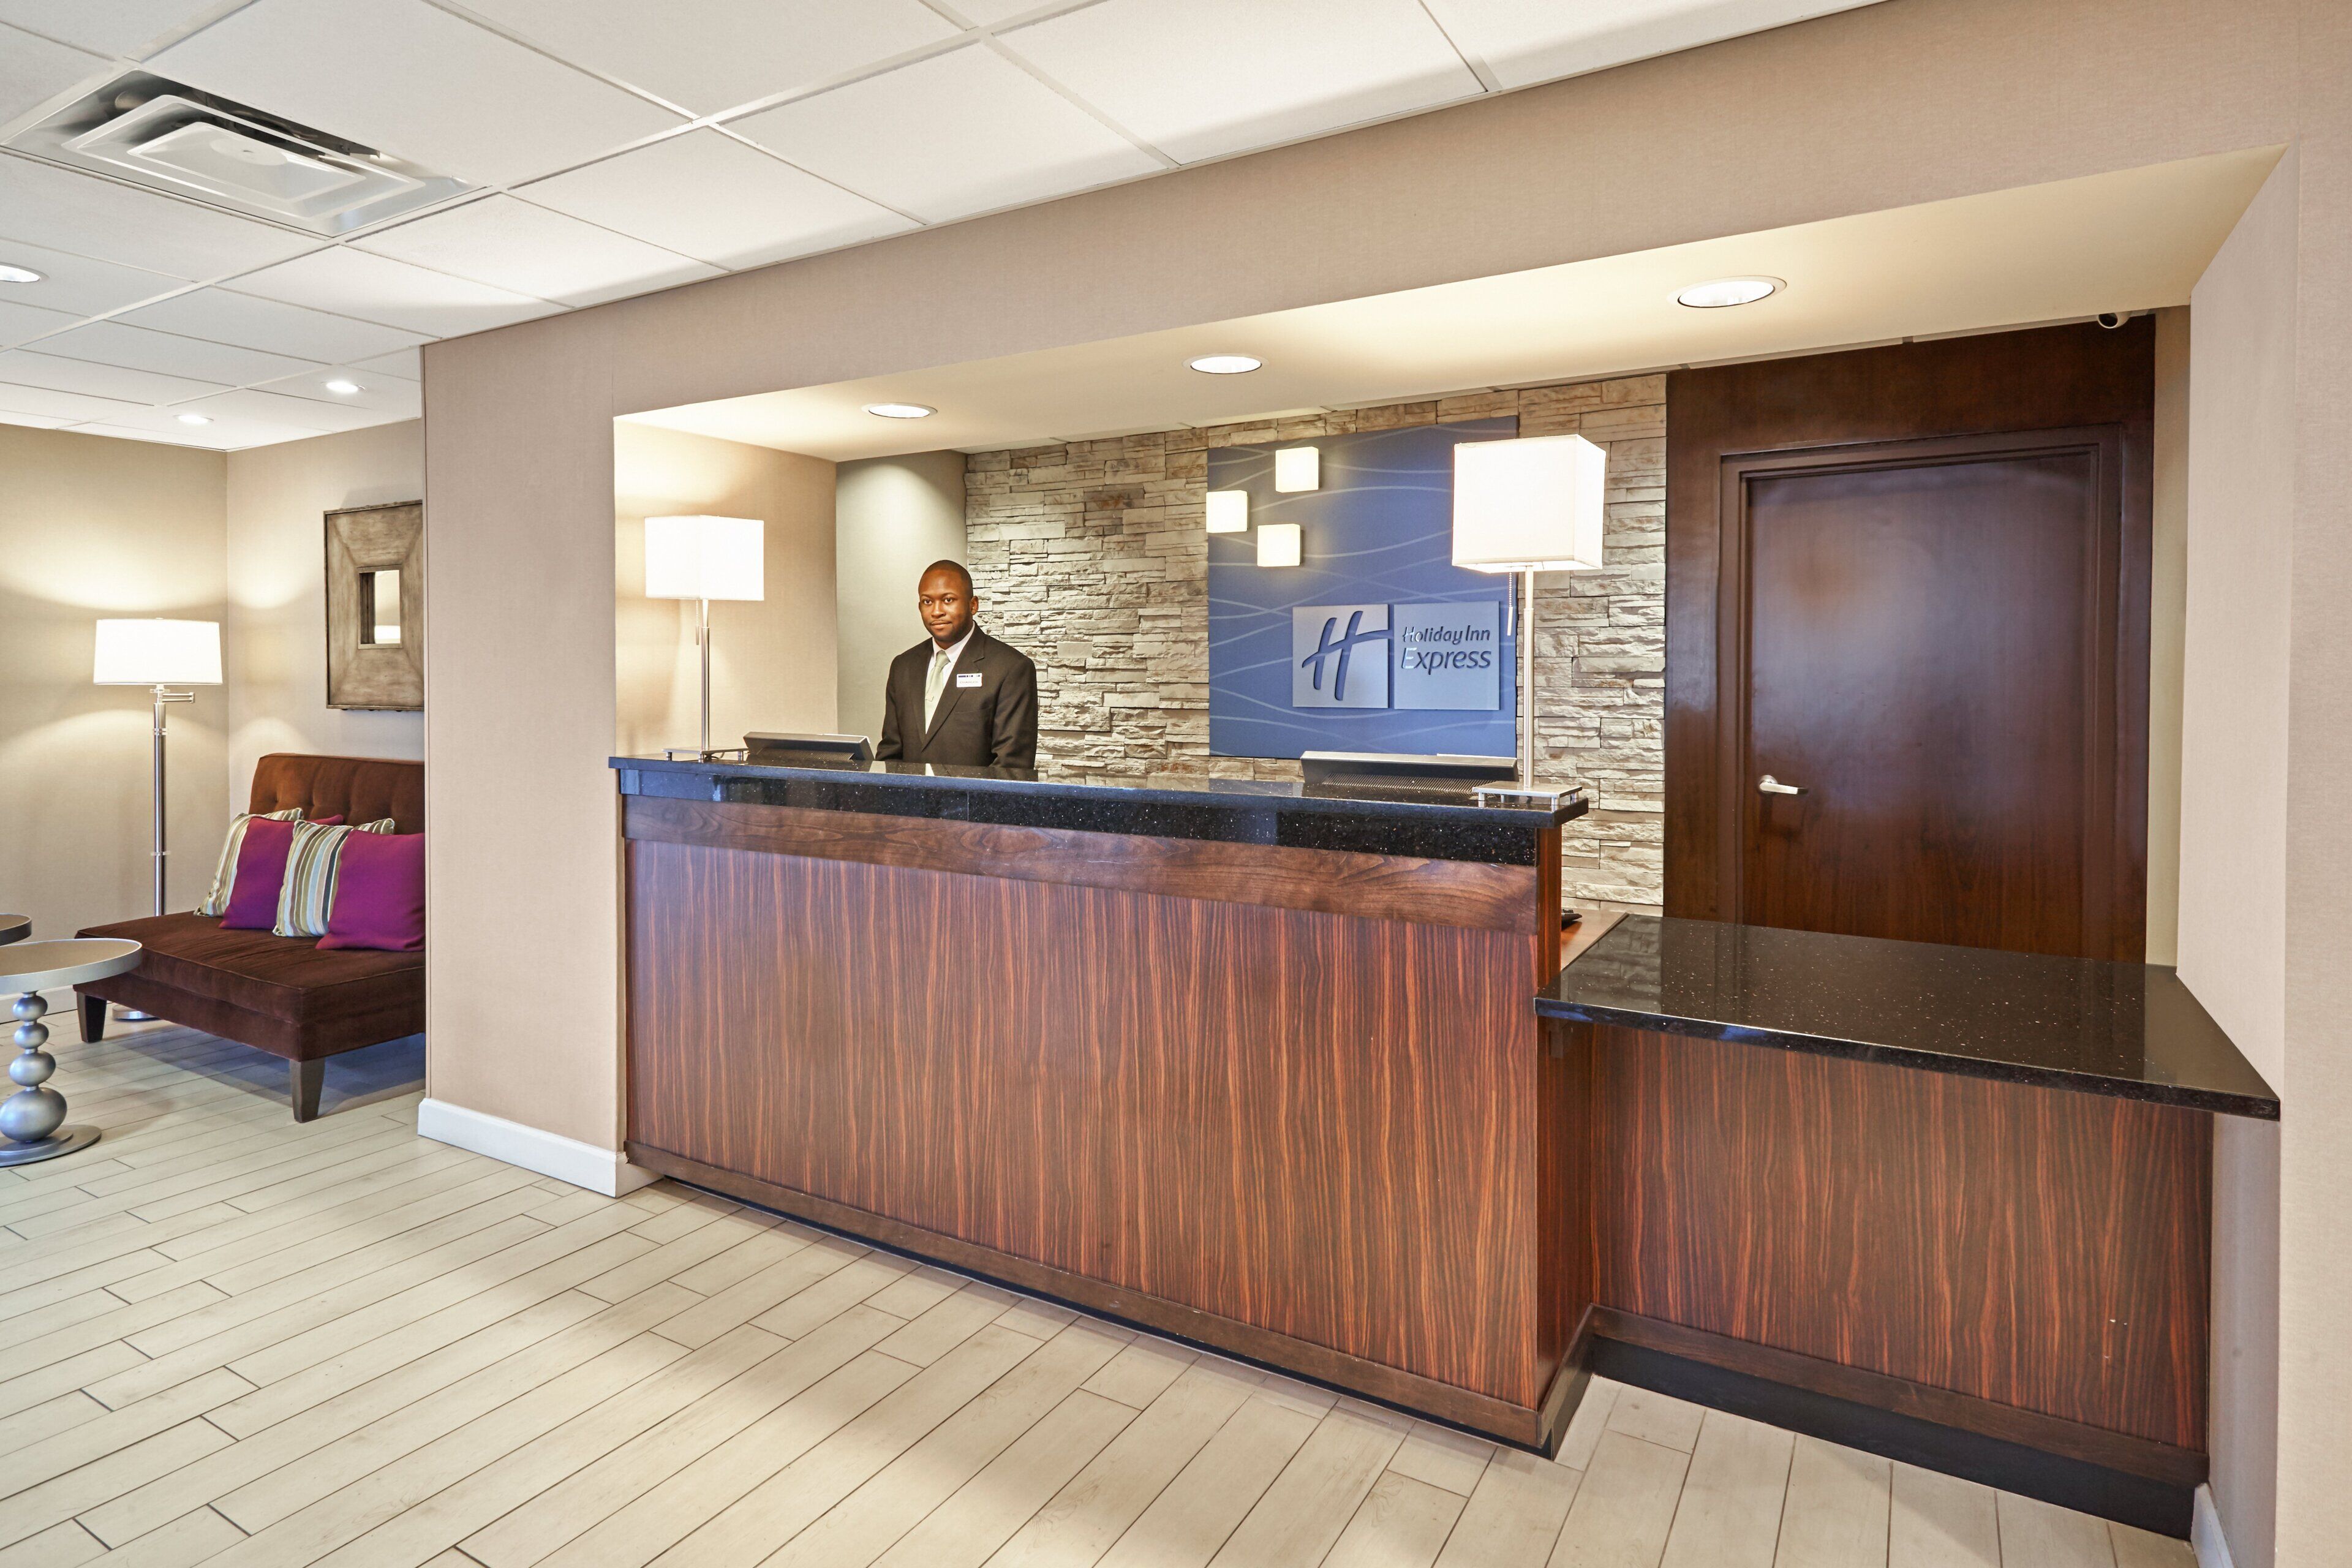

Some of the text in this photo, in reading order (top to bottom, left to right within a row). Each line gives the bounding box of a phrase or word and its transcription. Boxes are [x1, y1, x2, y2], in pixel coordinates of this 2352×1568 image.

[1403, 625, 1490, 645] Holiday Inn
[1401, 647, 1491, 676] Express
